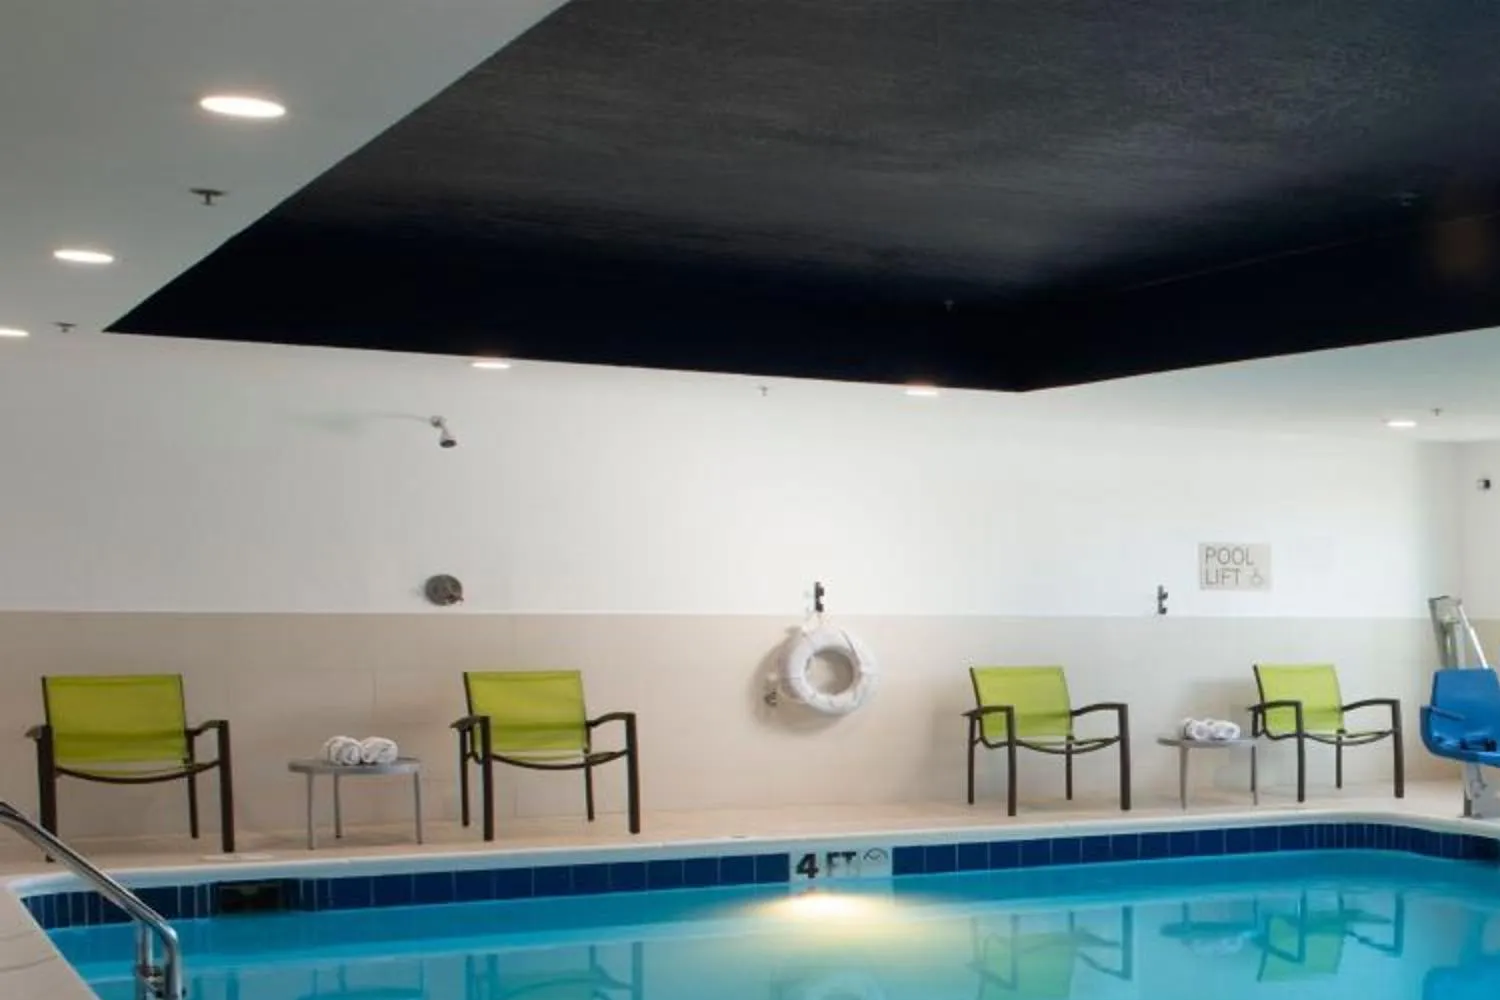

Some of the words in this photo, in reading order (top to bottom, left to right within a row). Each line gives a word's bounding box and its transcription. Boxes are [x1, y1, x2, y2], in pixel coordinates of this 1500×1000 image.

[1205, 546, 1254, 566] POOL
[1205, 567, 1242, 586] LIFT
[796, 853, 819, 878] 4
[826, 851, 857, 878] FT
